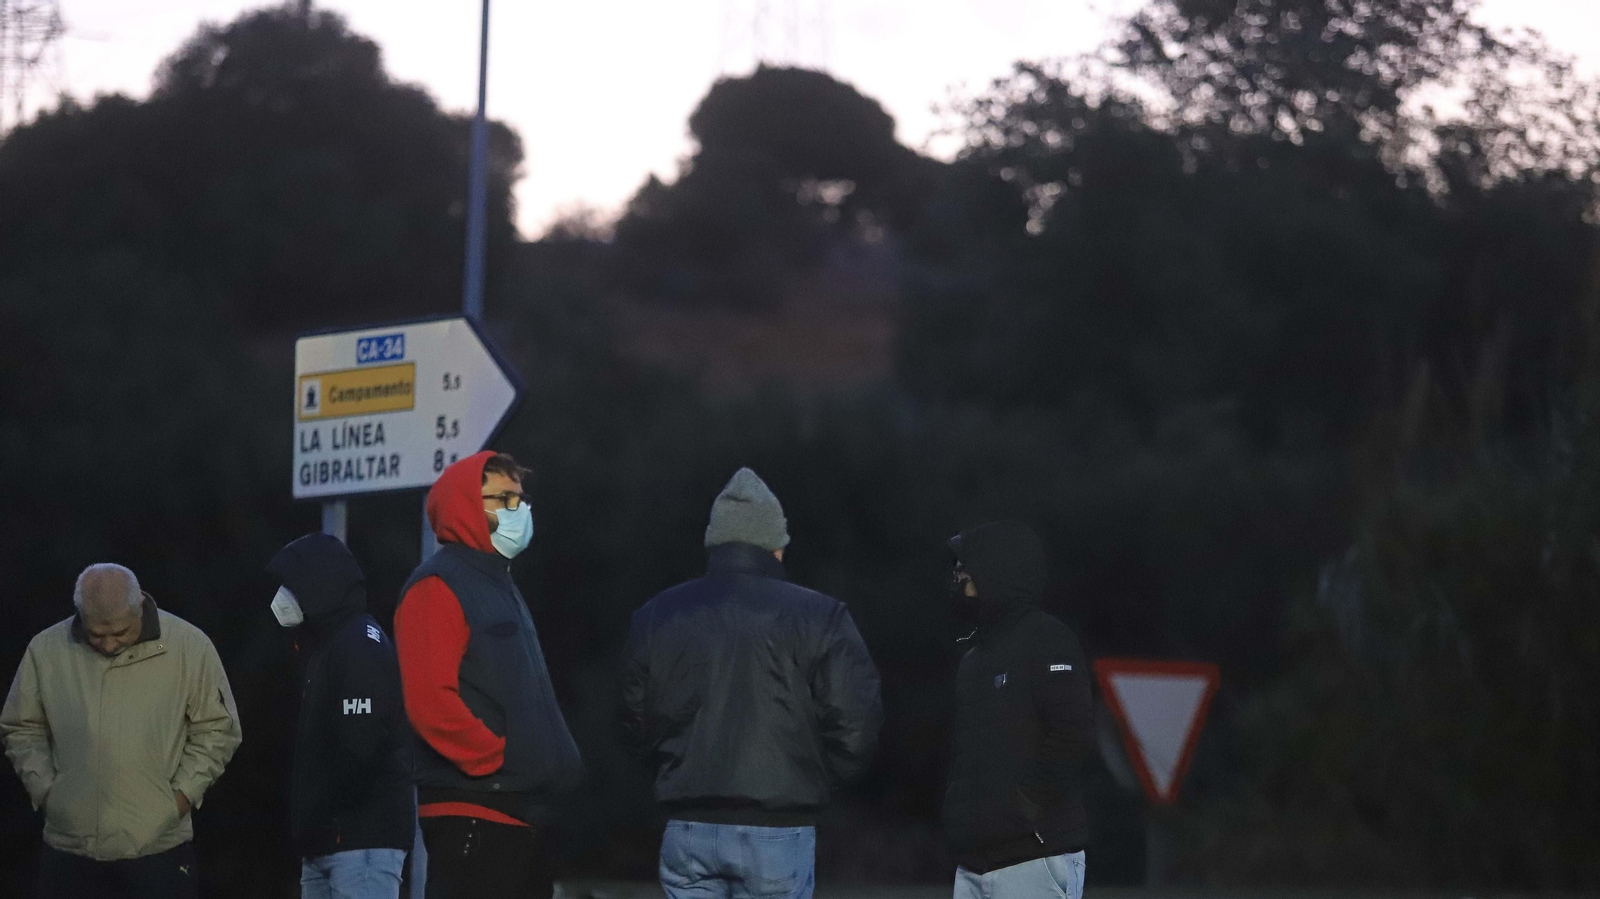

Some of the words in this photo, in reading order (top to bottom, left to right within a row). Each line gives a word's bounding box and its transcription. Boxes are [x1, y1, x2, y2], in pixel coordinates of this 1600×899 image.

[358, 337, 404, 361] CA-34
[329, 381, 412, 403] Campamento
[300, 428, 321, 452] LA
[332, 421, 385, 450] LÍNEA
[299, 454, 400, 485] GIBRALTAR
